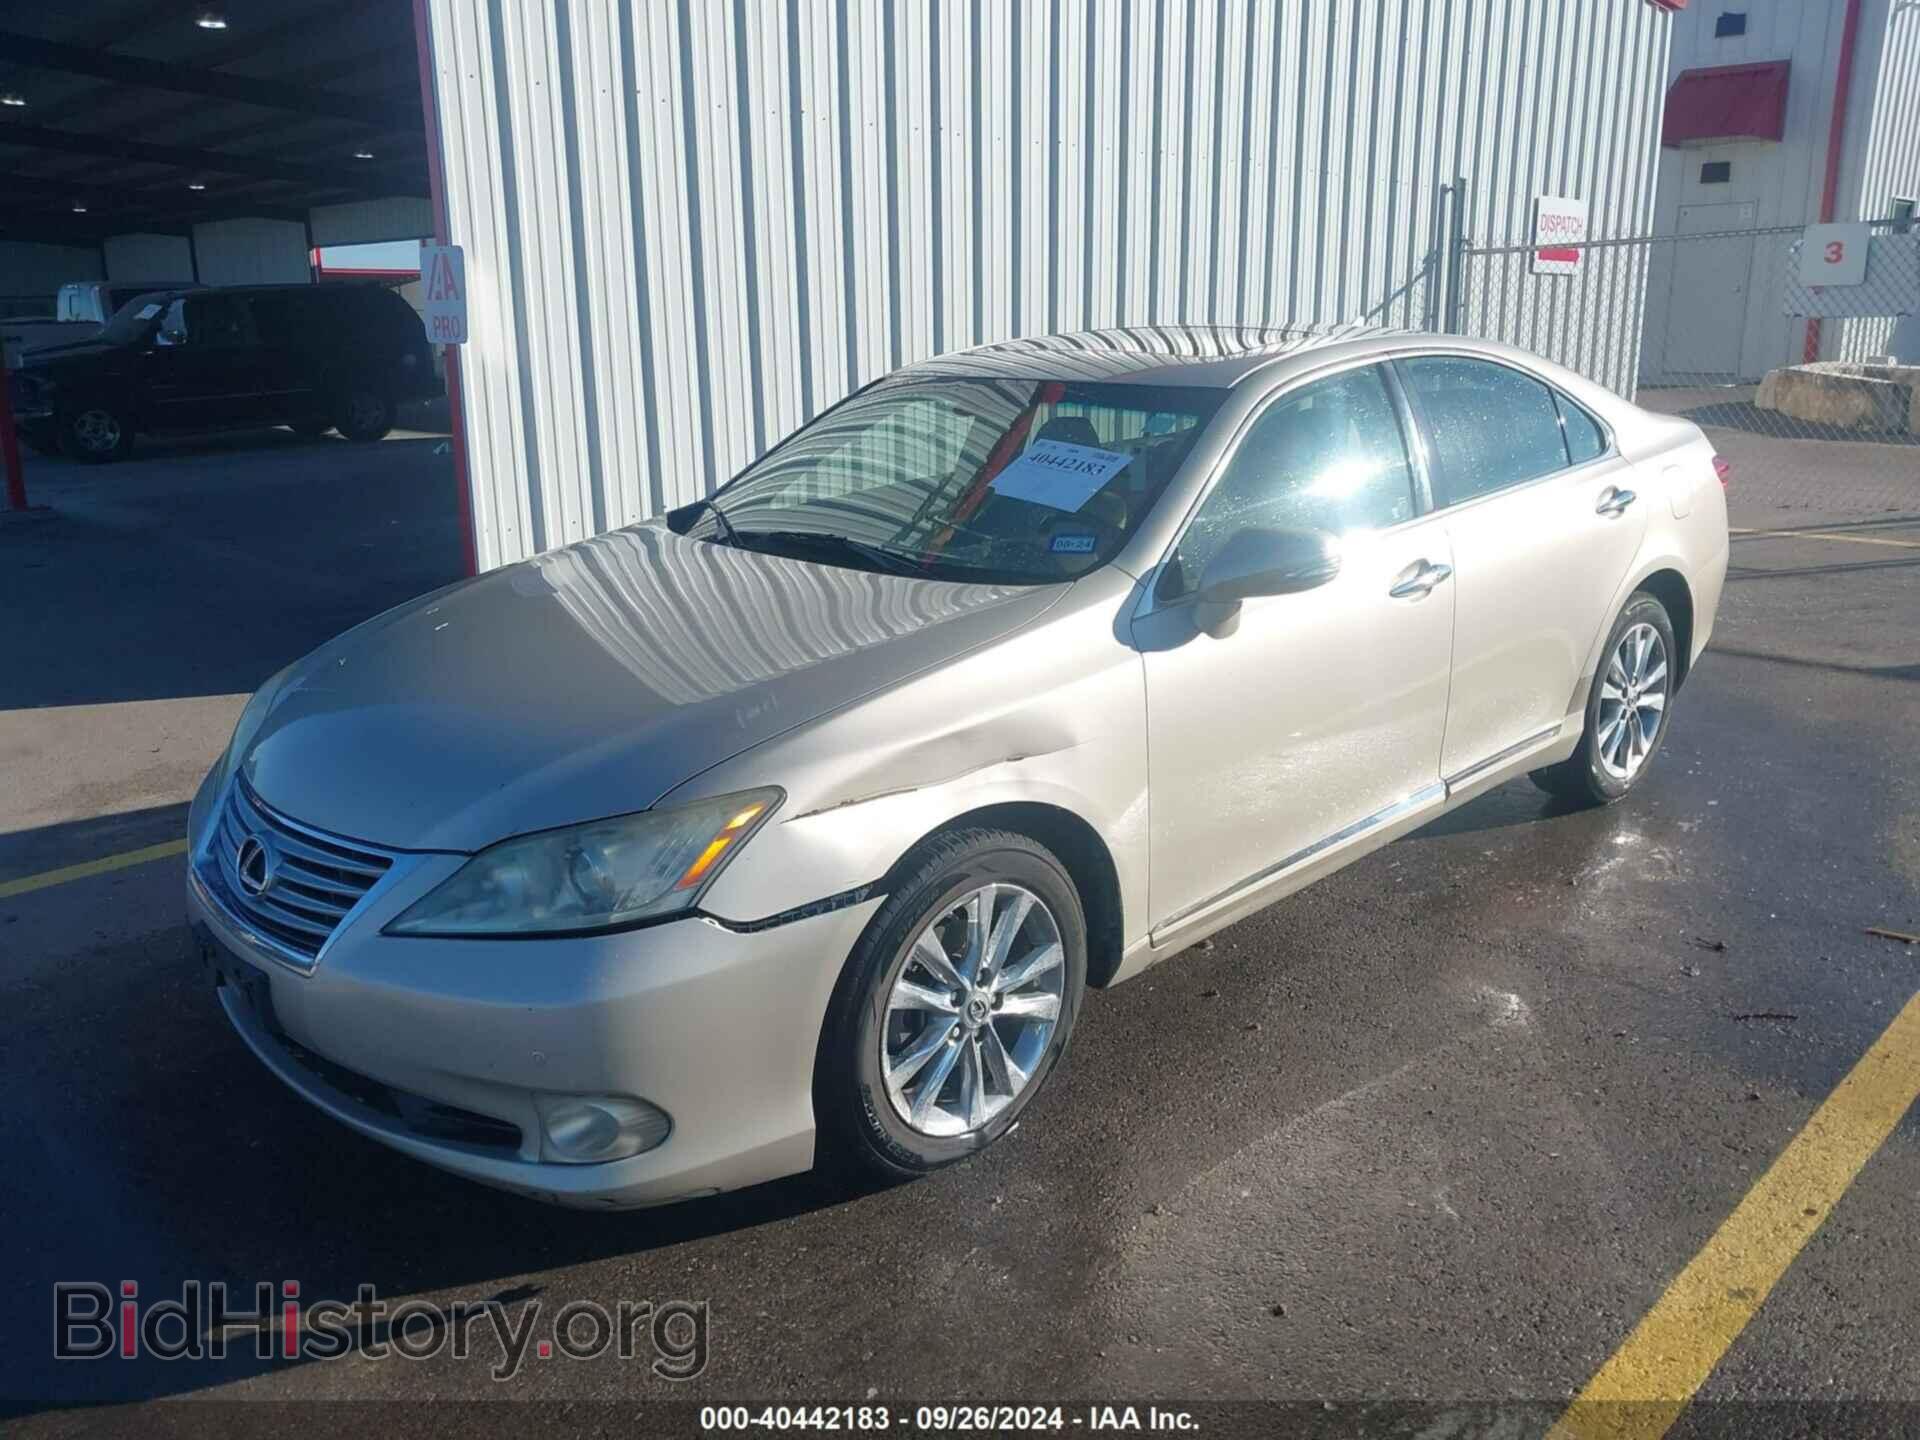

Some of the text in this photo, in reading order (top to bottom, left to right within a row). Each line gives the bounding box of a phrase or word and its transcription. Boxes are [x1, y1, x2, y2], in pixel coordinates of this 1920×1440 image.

[1540, 213, 1584, 234] DISPATCH
[1823, 240, 1843, 264] 3
[433, 316, 460, 338] PRO
[1028, 452, 1106, 475] 40442183
